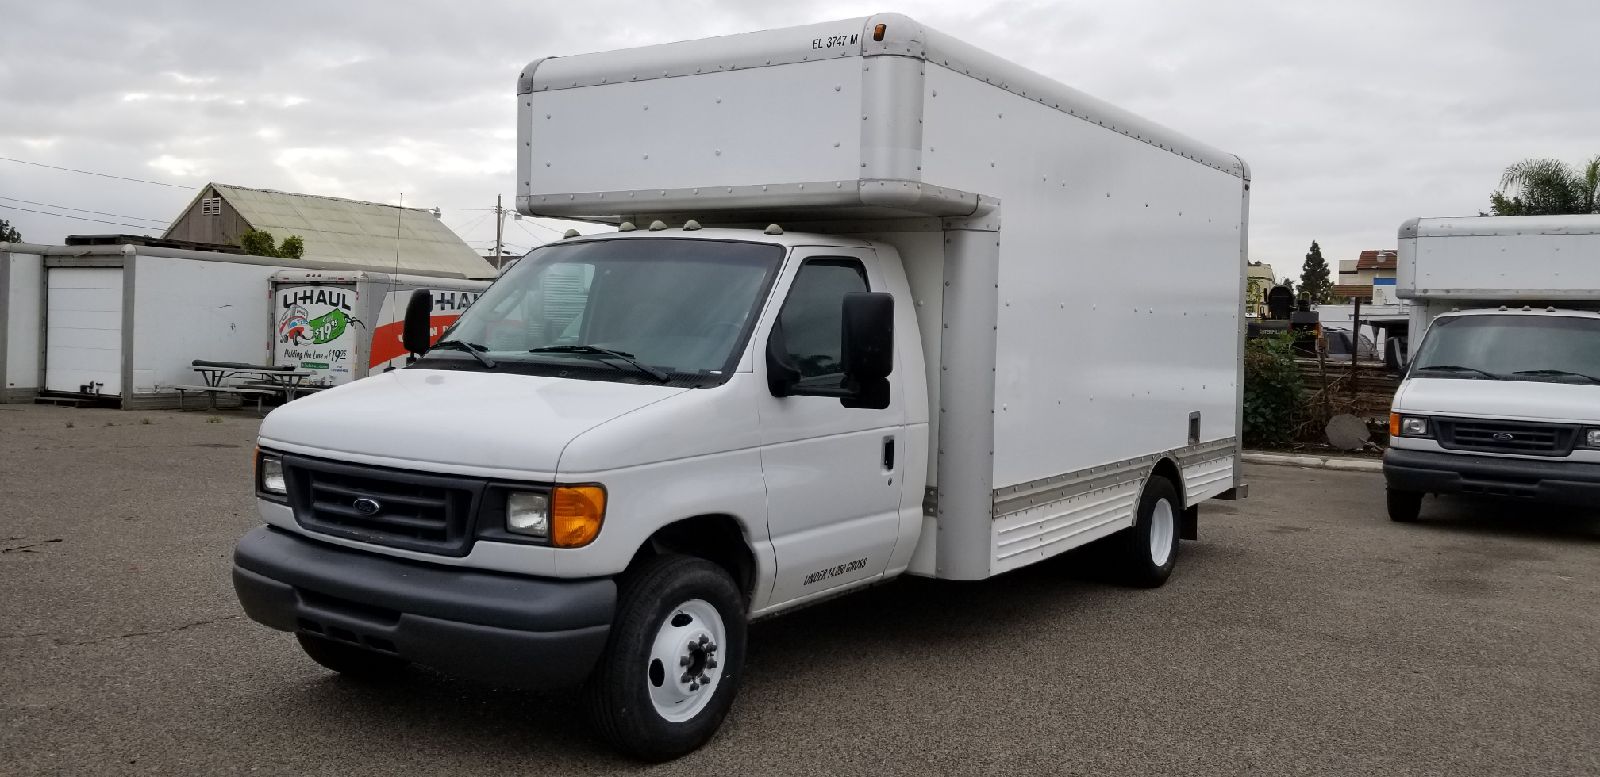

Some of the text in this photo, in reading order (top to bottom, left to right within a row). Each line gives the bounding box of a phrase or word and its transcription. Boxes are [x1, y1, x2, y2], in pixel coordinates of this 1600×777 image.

[812, 33, 858, 49] EL 3747 M
[283, 289, 352, 311] U-HAUL
